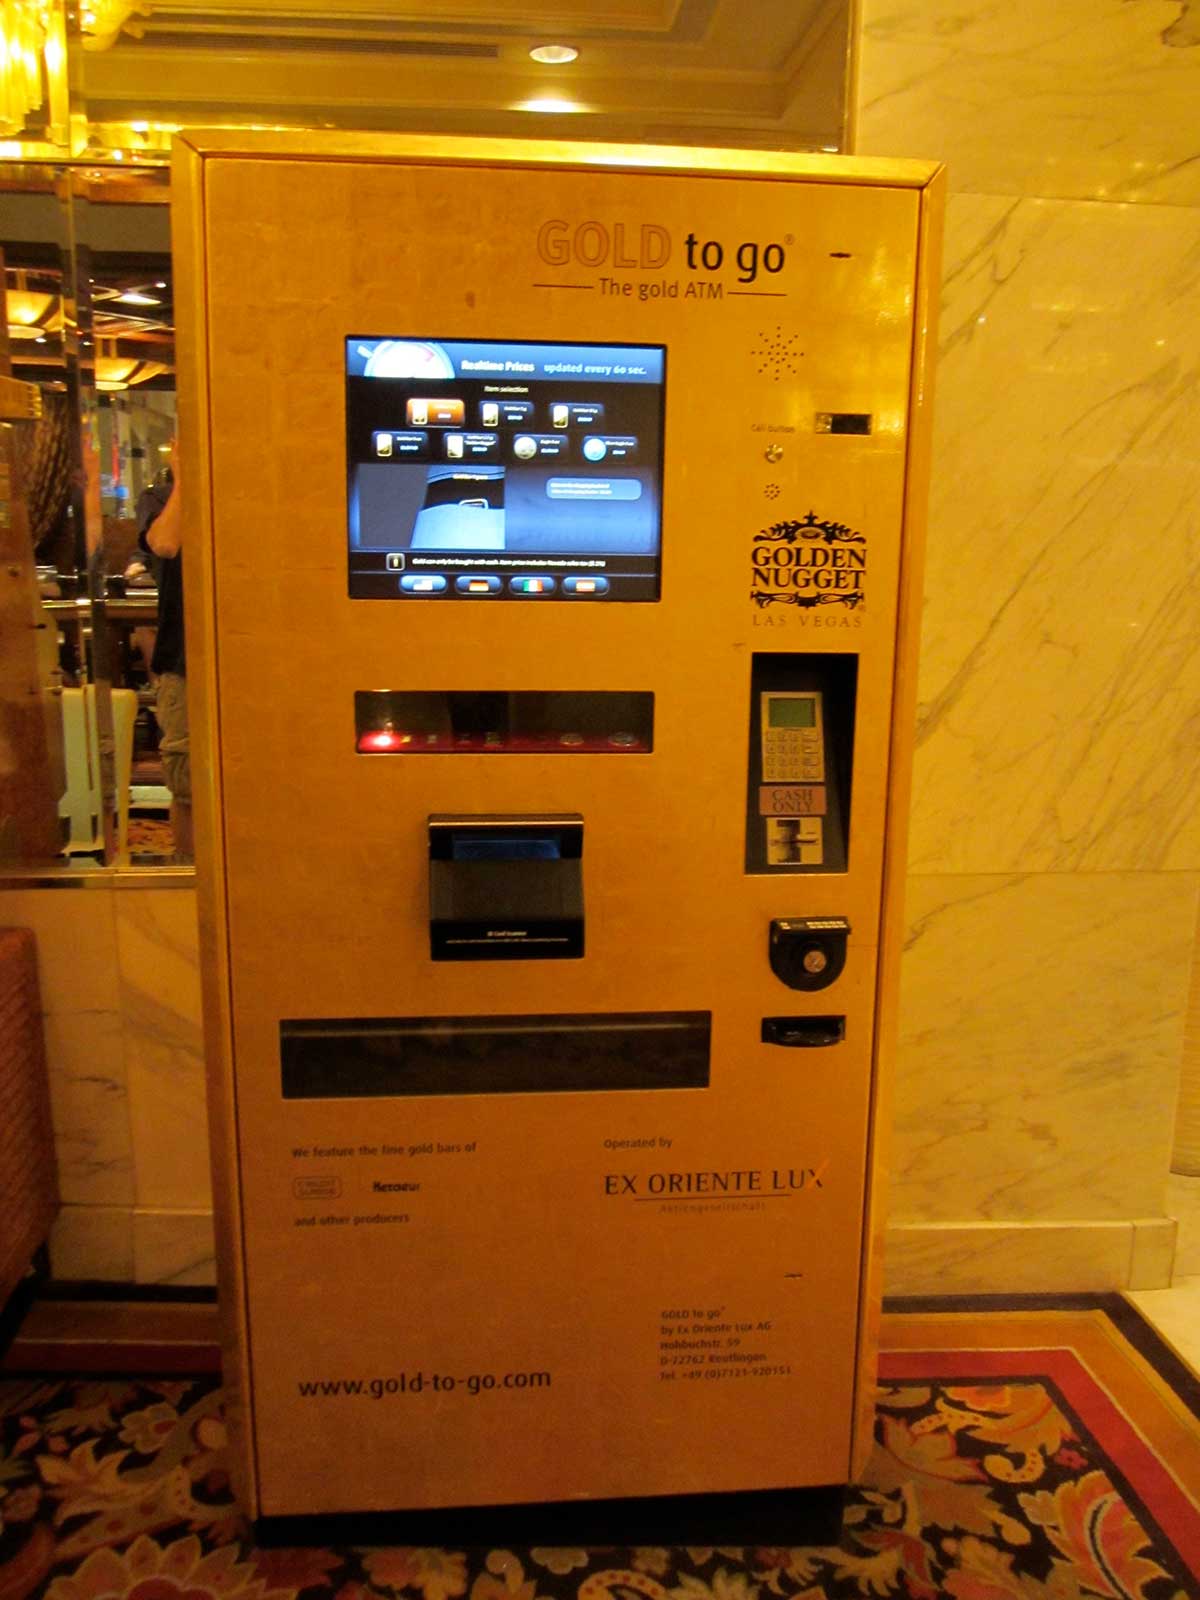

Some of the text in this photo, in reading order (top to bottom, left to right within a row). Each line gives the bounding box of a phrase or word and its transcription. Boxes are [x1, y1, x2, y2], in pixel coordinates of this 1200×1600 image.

[536, 219, 785, 284] GOLD to go
[599, 277, 723, 301] The gold ATM
[461, 360, 647, 376] Realtime Prices updated every 60 sec.
[751, 546, 868, 568] GOLDEN
[751, 567, 866, 589] NUGGET
[752, 614, 863, 628] LAS VEGAS
[772, 789, 813, 801] CASH
[772, 801, 814, 813] ONLY
[292, 1142, 477, 1158] We feature the fine gold bars of
[603, 1137, 672, 1149] Operated by
[604, 1166, 825, 1196] EX ORIENTE LUX
[295, 1213, 410, 1227] and other producers
[661, 1310, 689, 1320] GOLD
[692, 1309, 704, 1318] to
[660, 1321, 772, 1337] by Ex Oriente Lux AG
[727, 1338, 741, 1347] 59
[708, 1353, 767, 1365] Reutlingen
[298, 1371, 551, 1399] www.gold-to-go.com
